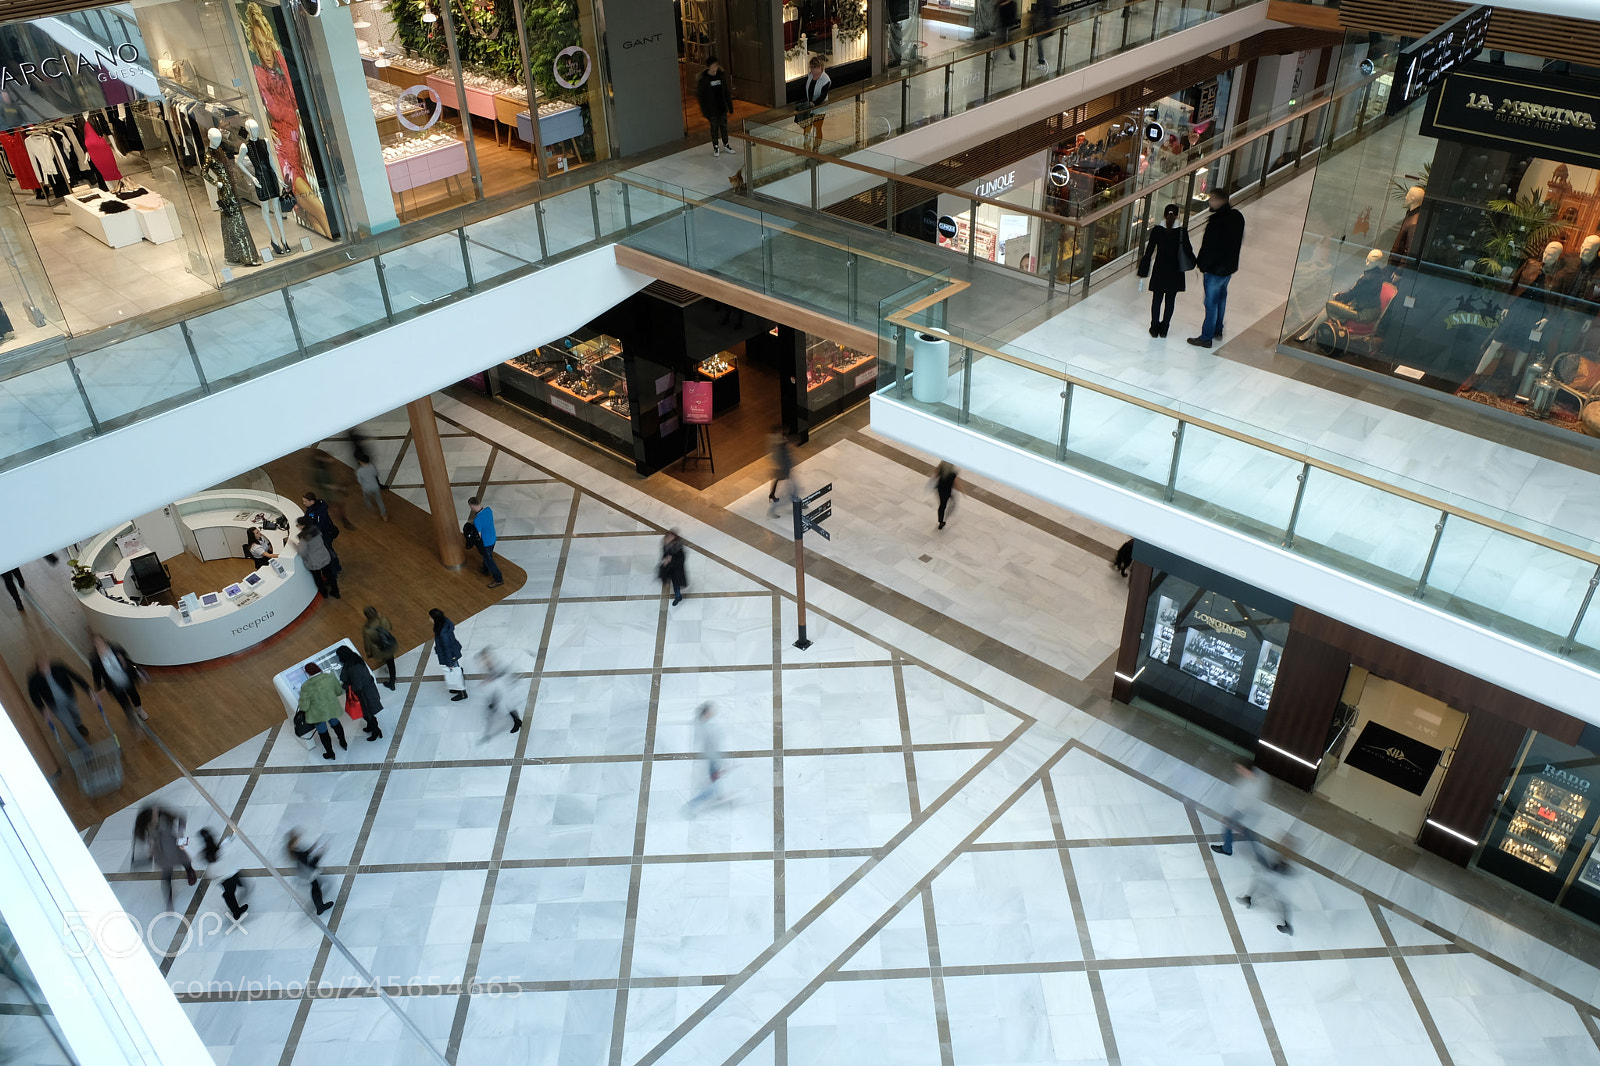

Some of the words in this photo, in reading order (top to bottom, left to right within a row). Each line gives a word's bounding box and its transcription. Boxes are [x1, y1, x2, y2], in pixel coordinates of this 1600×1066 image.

[622, 33, 662, 50] GANT
[97, 67, 144, 82] GUESS
[1404, 57, 1417, 100] 1
[1494, 113, 1531, 126] BUENOS
[1534, 120, 1561, 131] AIRES
[1496, 98, 1597, 130] MARTINA
[975, 170, 1016, 197] CLINIQUE
[1452, 313, 1481, 325] SALE
[231, 610, 275, 636] recepcia
[1193, 610, 1247, 639] LONGINES
[1544, 763, 1590, 789] RADO
